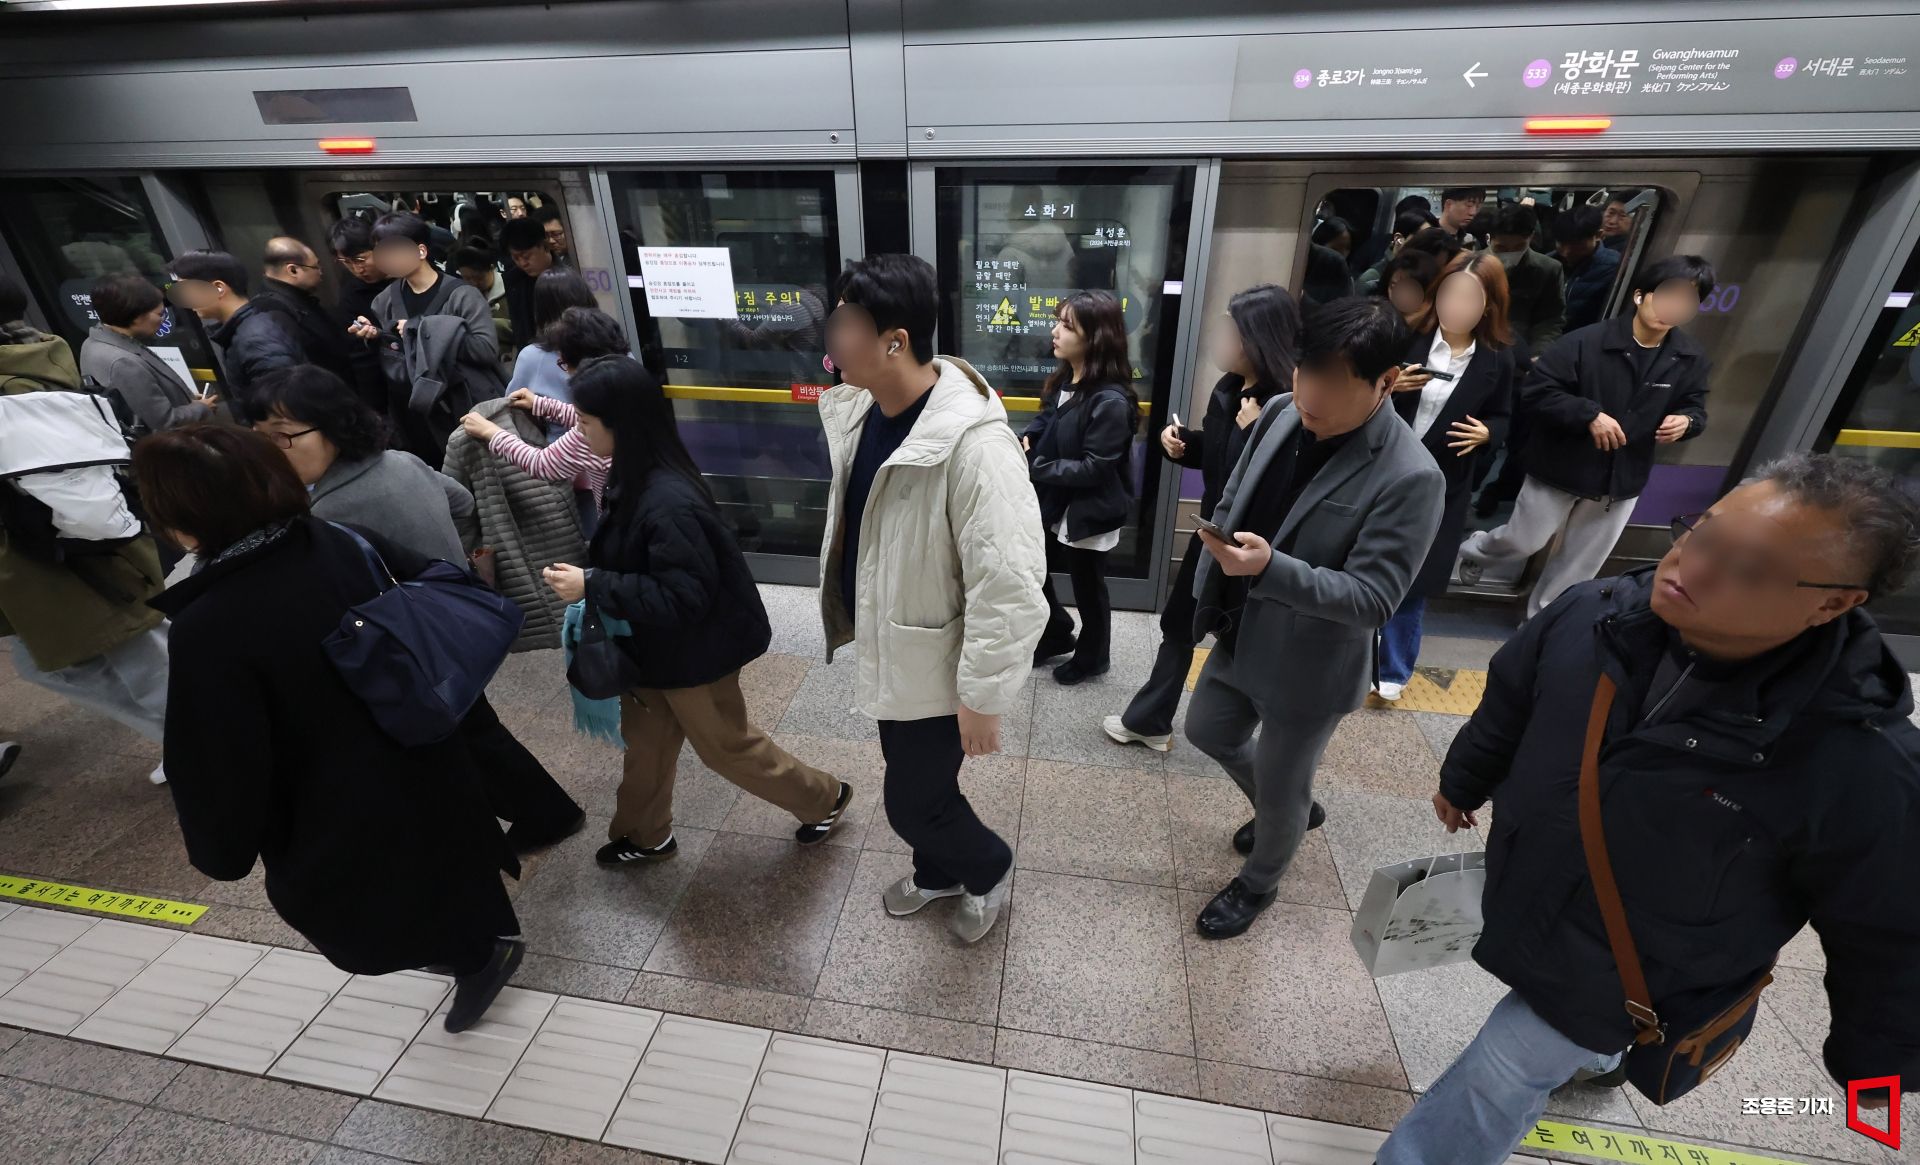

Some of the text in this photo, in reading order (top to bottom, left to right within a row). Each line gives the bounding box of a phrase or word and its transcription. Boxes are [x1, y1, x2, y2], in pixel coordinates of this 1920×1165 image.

[1652, 48, 1739, 61] Gwanghwamun
[1559, 49, 1640, 81] 광화문
[1864, 57, 1906, 65] Seodaemun
[1372, 68, 1393, 76] Jongno
[1648, 62, 1731, 73] (Sejong Center for the
[1777, 64, 1794, 72] 532
[1802, 57, 1855, 77] 서대문
[1295, 74, 1309, 83] 534
[1316, 68, 1365, 87] 종로3가
[1526, 69, 1548, 79] 533
[1656, 71, 1718, 81] Performing Arts)
[1553, 81, 1632, 95] (세종문화회관)
[975, 260, 1020, 270] 필요할 때만
[975, 271, 1011, 281] 급할 때만
[1003, 282, 1027, 292] 좋으니
[765, 291, 801, 306] 주의!
[975, 324, 983, 333] 그
[675, 354, 688, 364] 1-2
[87, 893, 168, 915] 여기까지만
